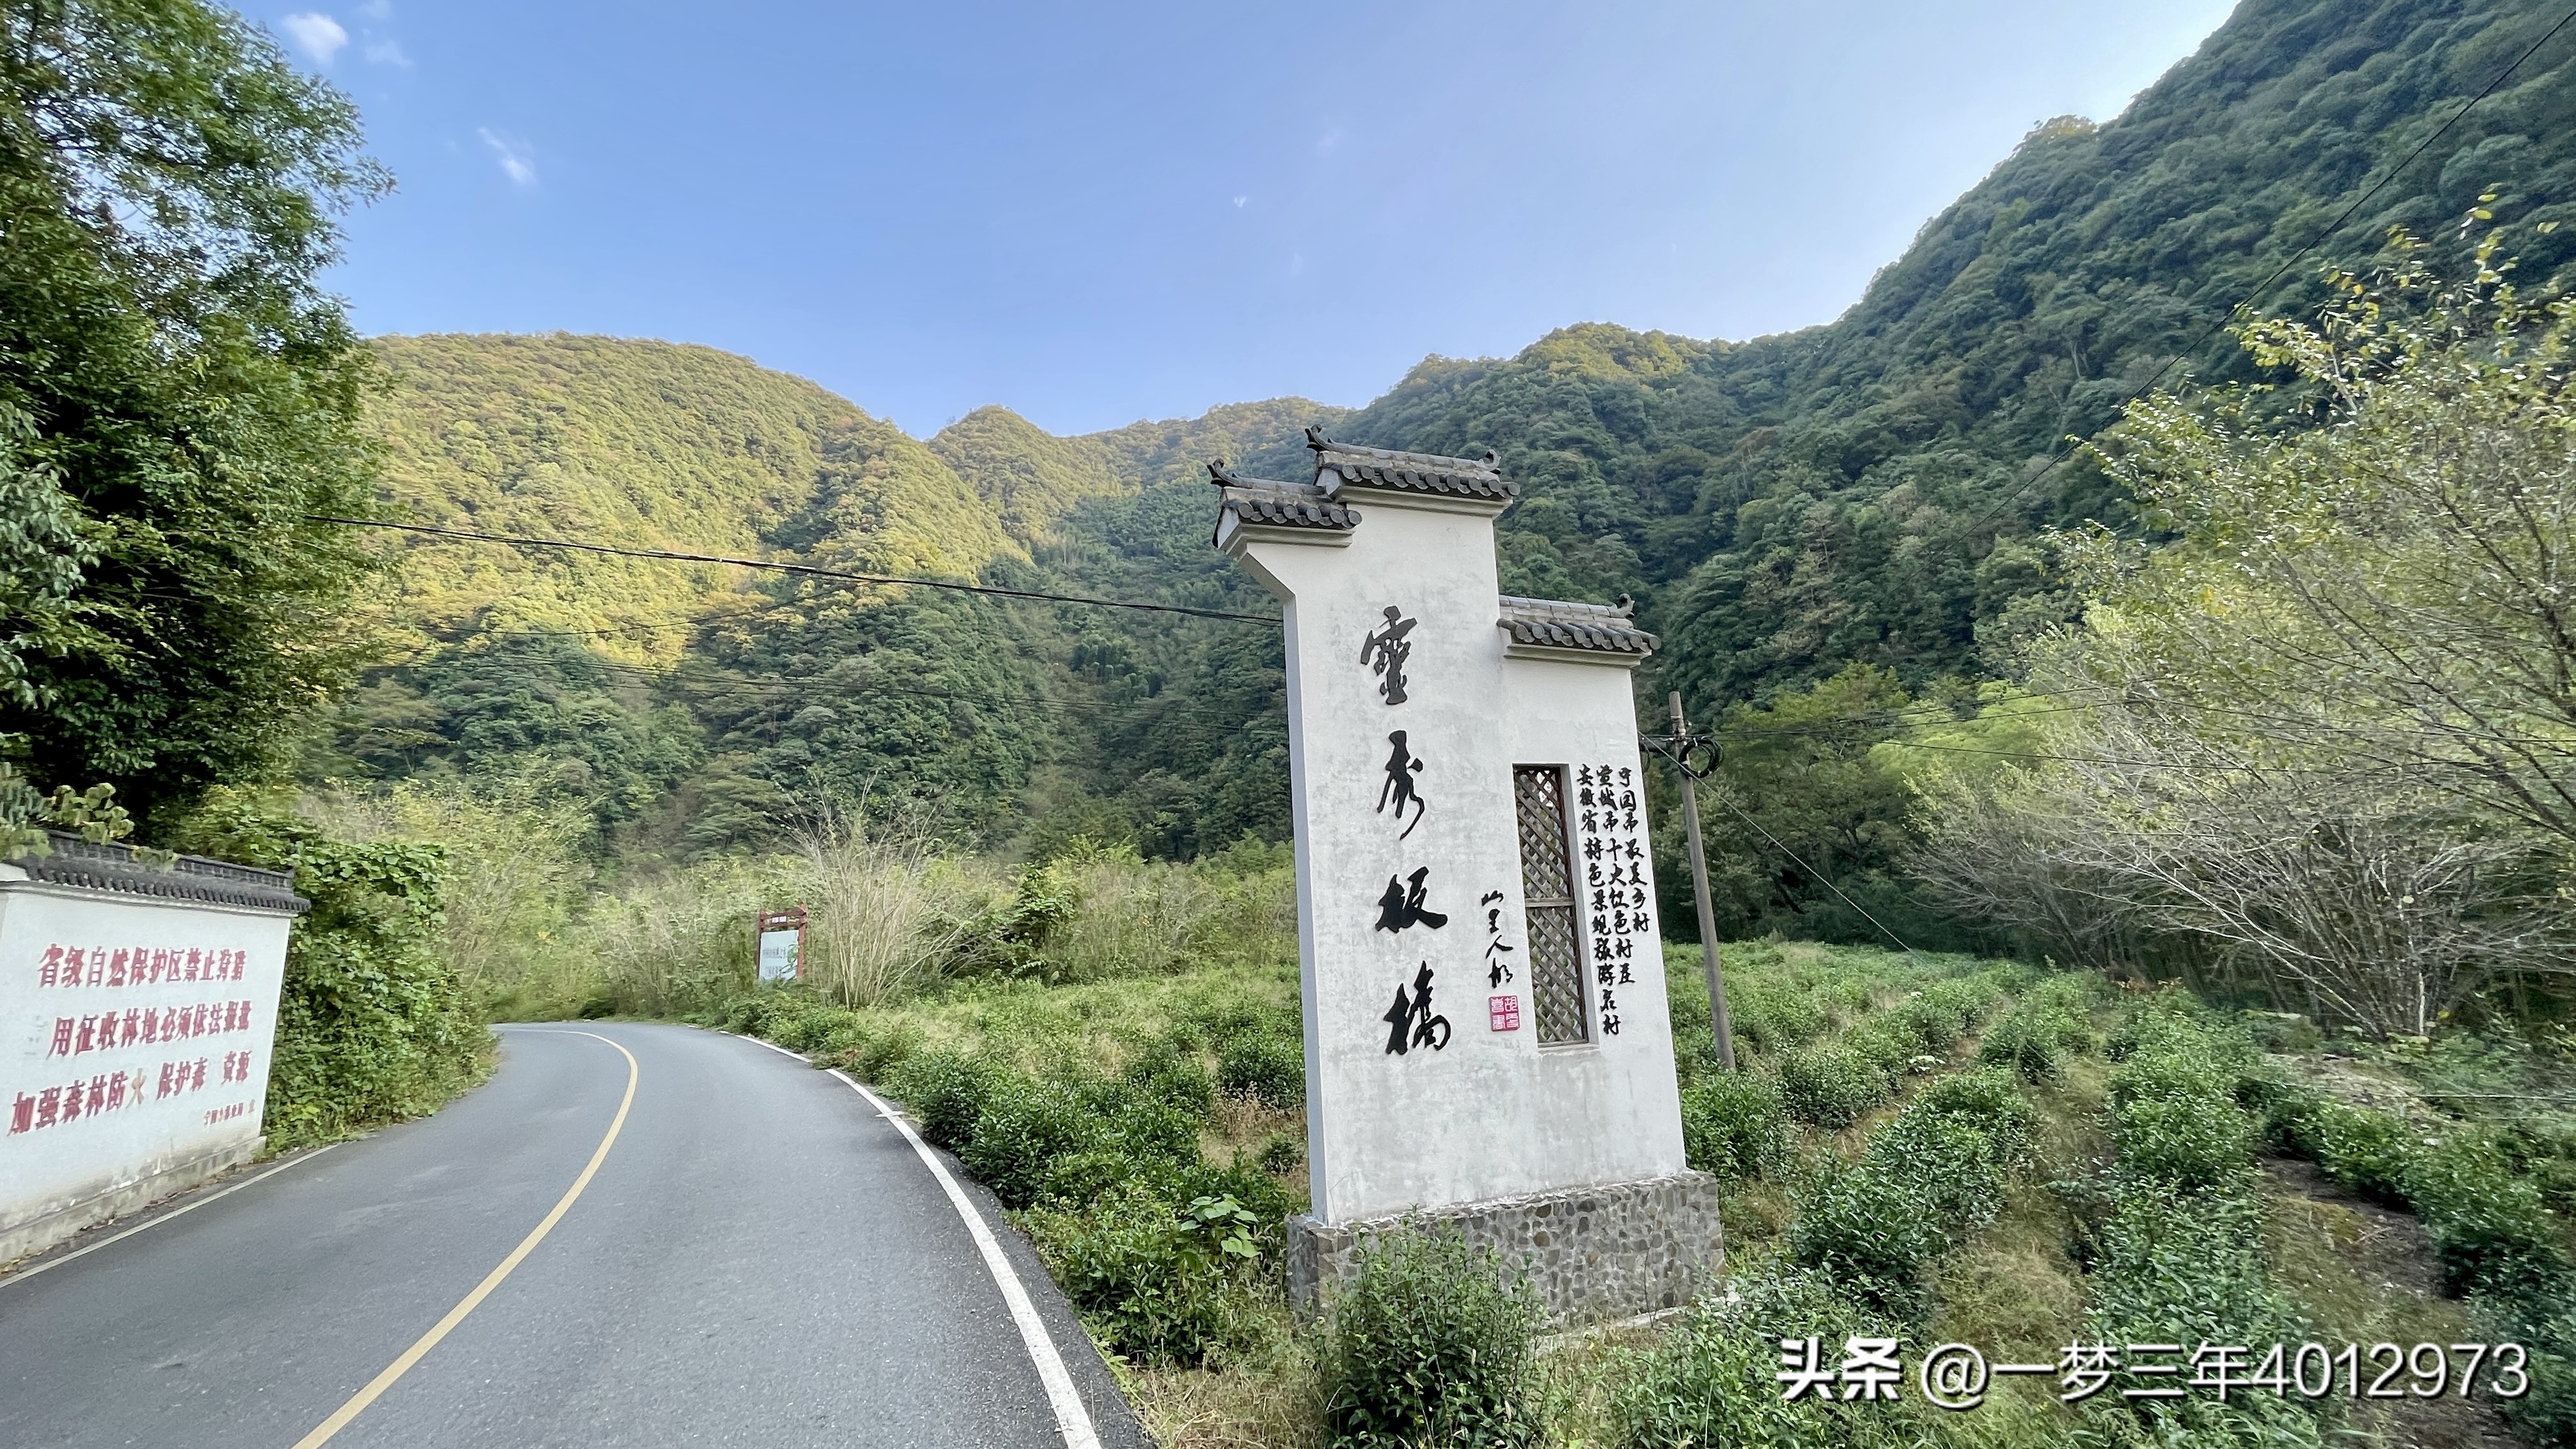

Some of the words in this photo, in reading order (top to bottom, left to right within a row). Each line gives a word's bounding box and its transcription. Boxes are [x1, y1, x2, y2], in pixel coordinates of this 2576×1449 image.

[38, 943, 247, 988] 省级自然保护区禁止狩猎
